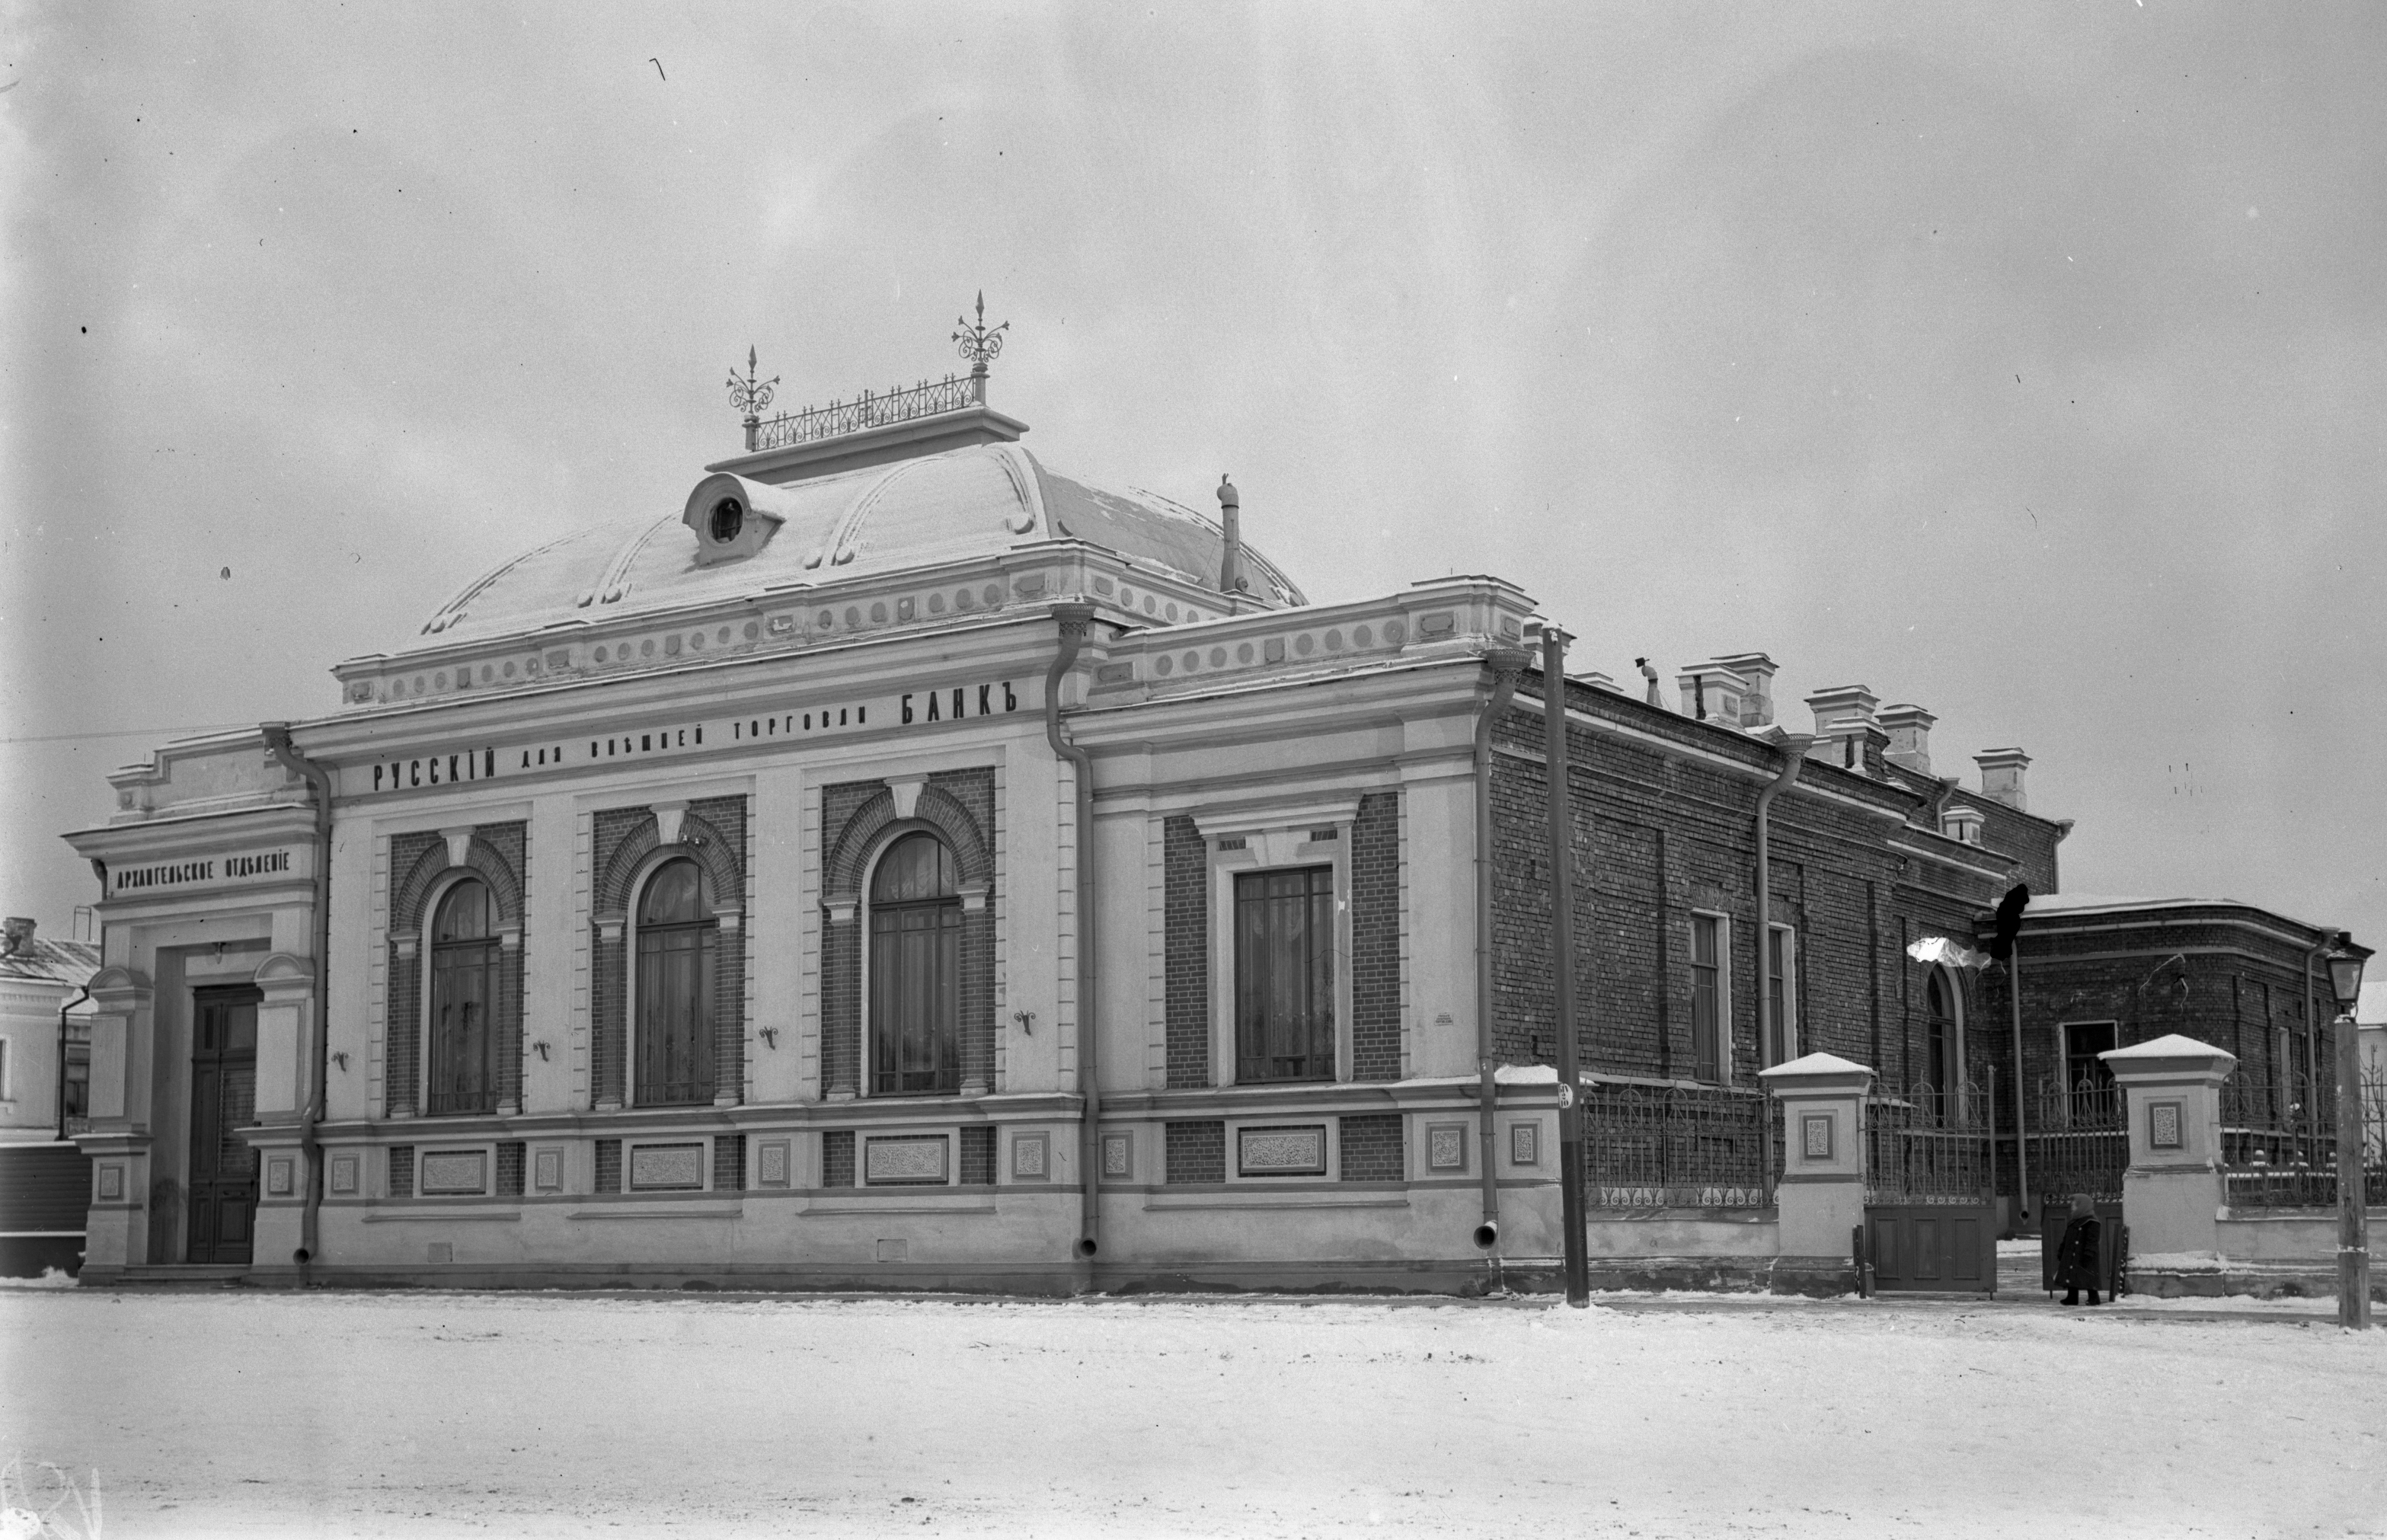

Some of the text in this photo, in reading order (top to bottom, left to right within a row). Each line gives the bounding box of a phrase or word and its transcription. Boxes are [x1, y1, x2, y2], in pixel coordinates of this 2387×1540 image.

[373, 681, 1017, 792] РУССКІЙ ДЛЯ ВНѢШНЕЙ ТОРГОВЛИ БАНКЪ
[117, 849, 290, 890] АРХАНГЕЛЬСКОЕ ОТДѢЛЕНІЕ
